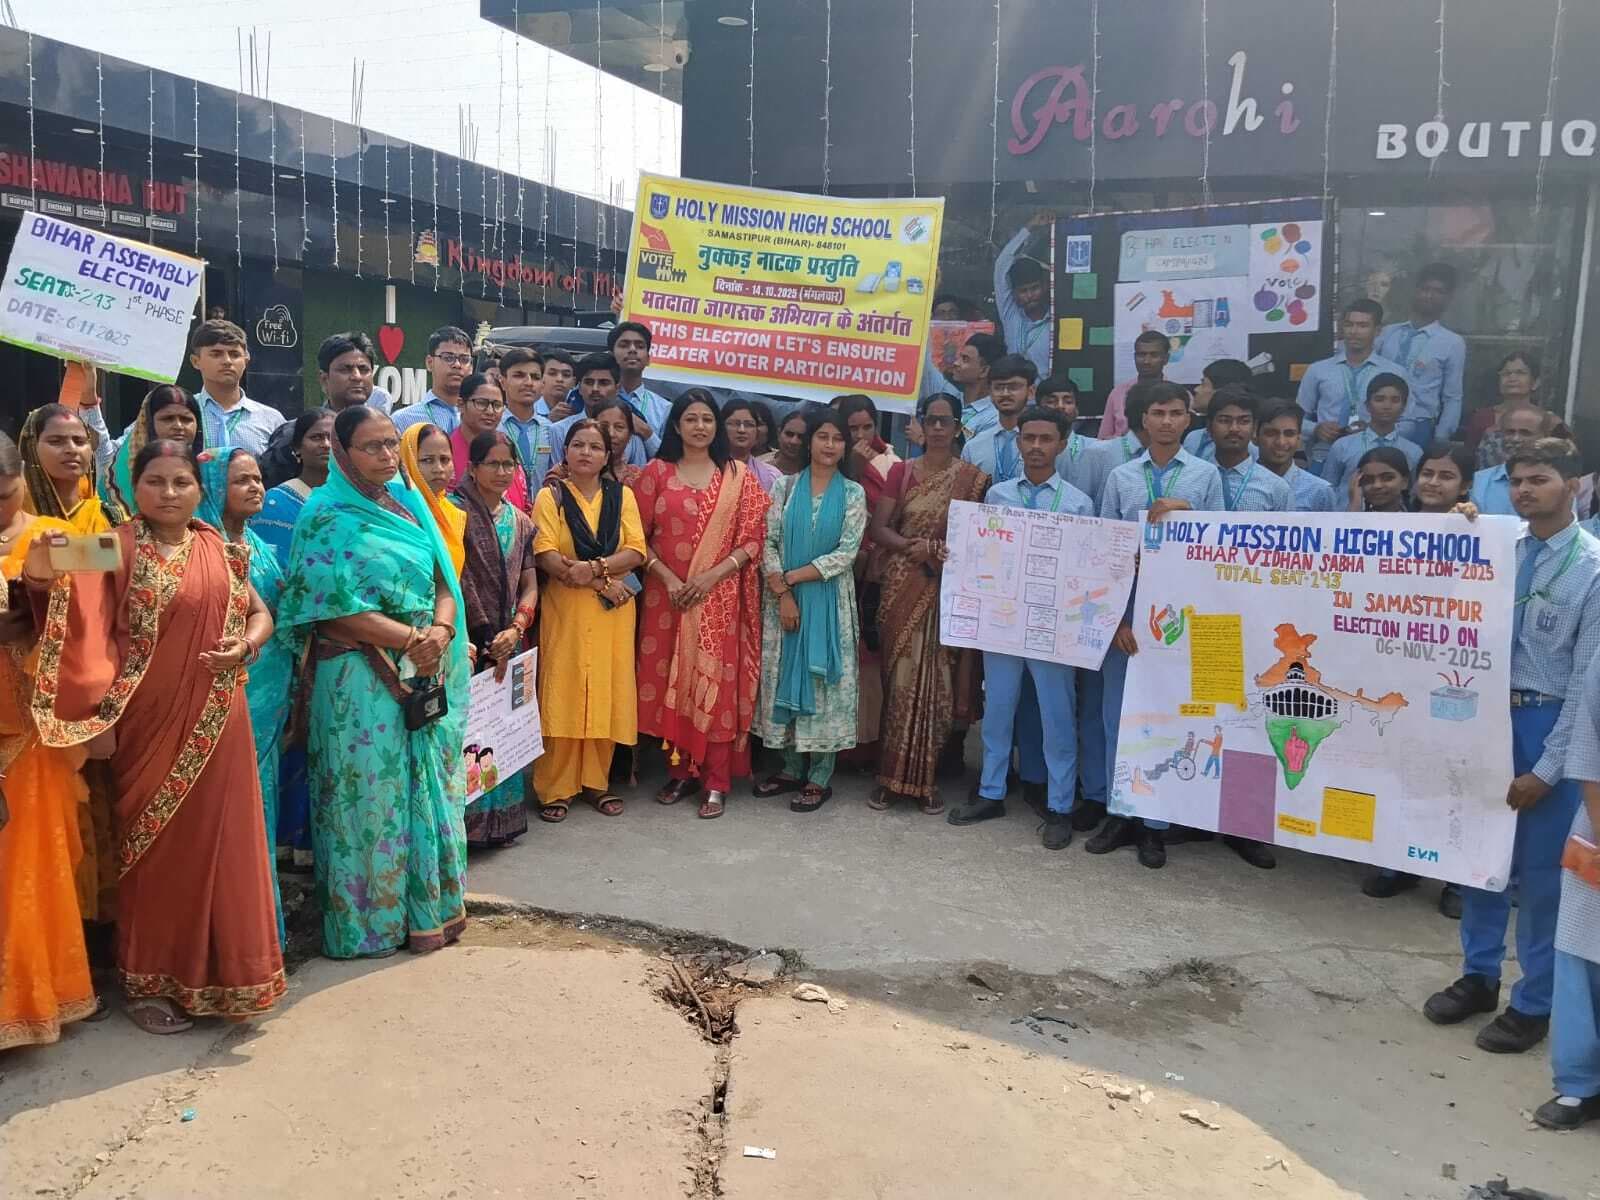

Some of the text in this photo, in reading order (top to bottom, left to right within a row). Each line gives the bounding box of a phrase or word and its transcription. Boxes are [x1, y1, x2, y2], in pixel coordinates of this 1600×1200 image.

[1007, 50, 1301, 156] Aarohi
[1376, 119, 1597, 160] BOUTIQ
[0, 152, 188, 215] SHAWARMA HUT
[675, 197, 893, 240] HOLY MISSION HIGH SCHOOL
[30, 217, 200, 288] BIHAR ASSEMBLY
[640, 251, 674, 267] VOTE
[707, 228, 772, 245] SAMASTIPUR
[816, 240, 848, 251] 848101
[78, 259, 171, 302] ELECTION
[447, 239, 556, 288] Kingdom
[561, 266, 584, 296] of
[697, 244, 860, 284] नुक्कड़ नाटक प्रस्तुति
[641, 290, 701, 316] मतदाता
[769, 303, 833, 328] अभियान
[836, 308, 854, 330] के
[751, 284, 798, 300] 14.10.2025
[144, 302, 185, 326] PHASE
[264, 318, 283, 329] Free
[262, 331, 290, 345] Wi-fi
[649, 320, 897, 364] THIS ELECTION LET'S ENSURE
[372, 364, 428, 405] OM
[649, 343, 907, 388] REATER VOTER PARTICIPATION
[976, 527, 1015, 544] VOTE
[1166, 521, 1491, 567] HOLY MISSION HIGH SCHOOL
[1187, 545, 1239, 564] BIHAR
[1244, 549, 1314, 571] VIDHAN
[1319, 553, 1365, 574] SABHA
[1215, 563, 1263, 585] TOTAL
[1333, 590, 1483, 623] IN SAMASTIPUR
[1333, 614, 1479, 649] ELECTION HELD ON
